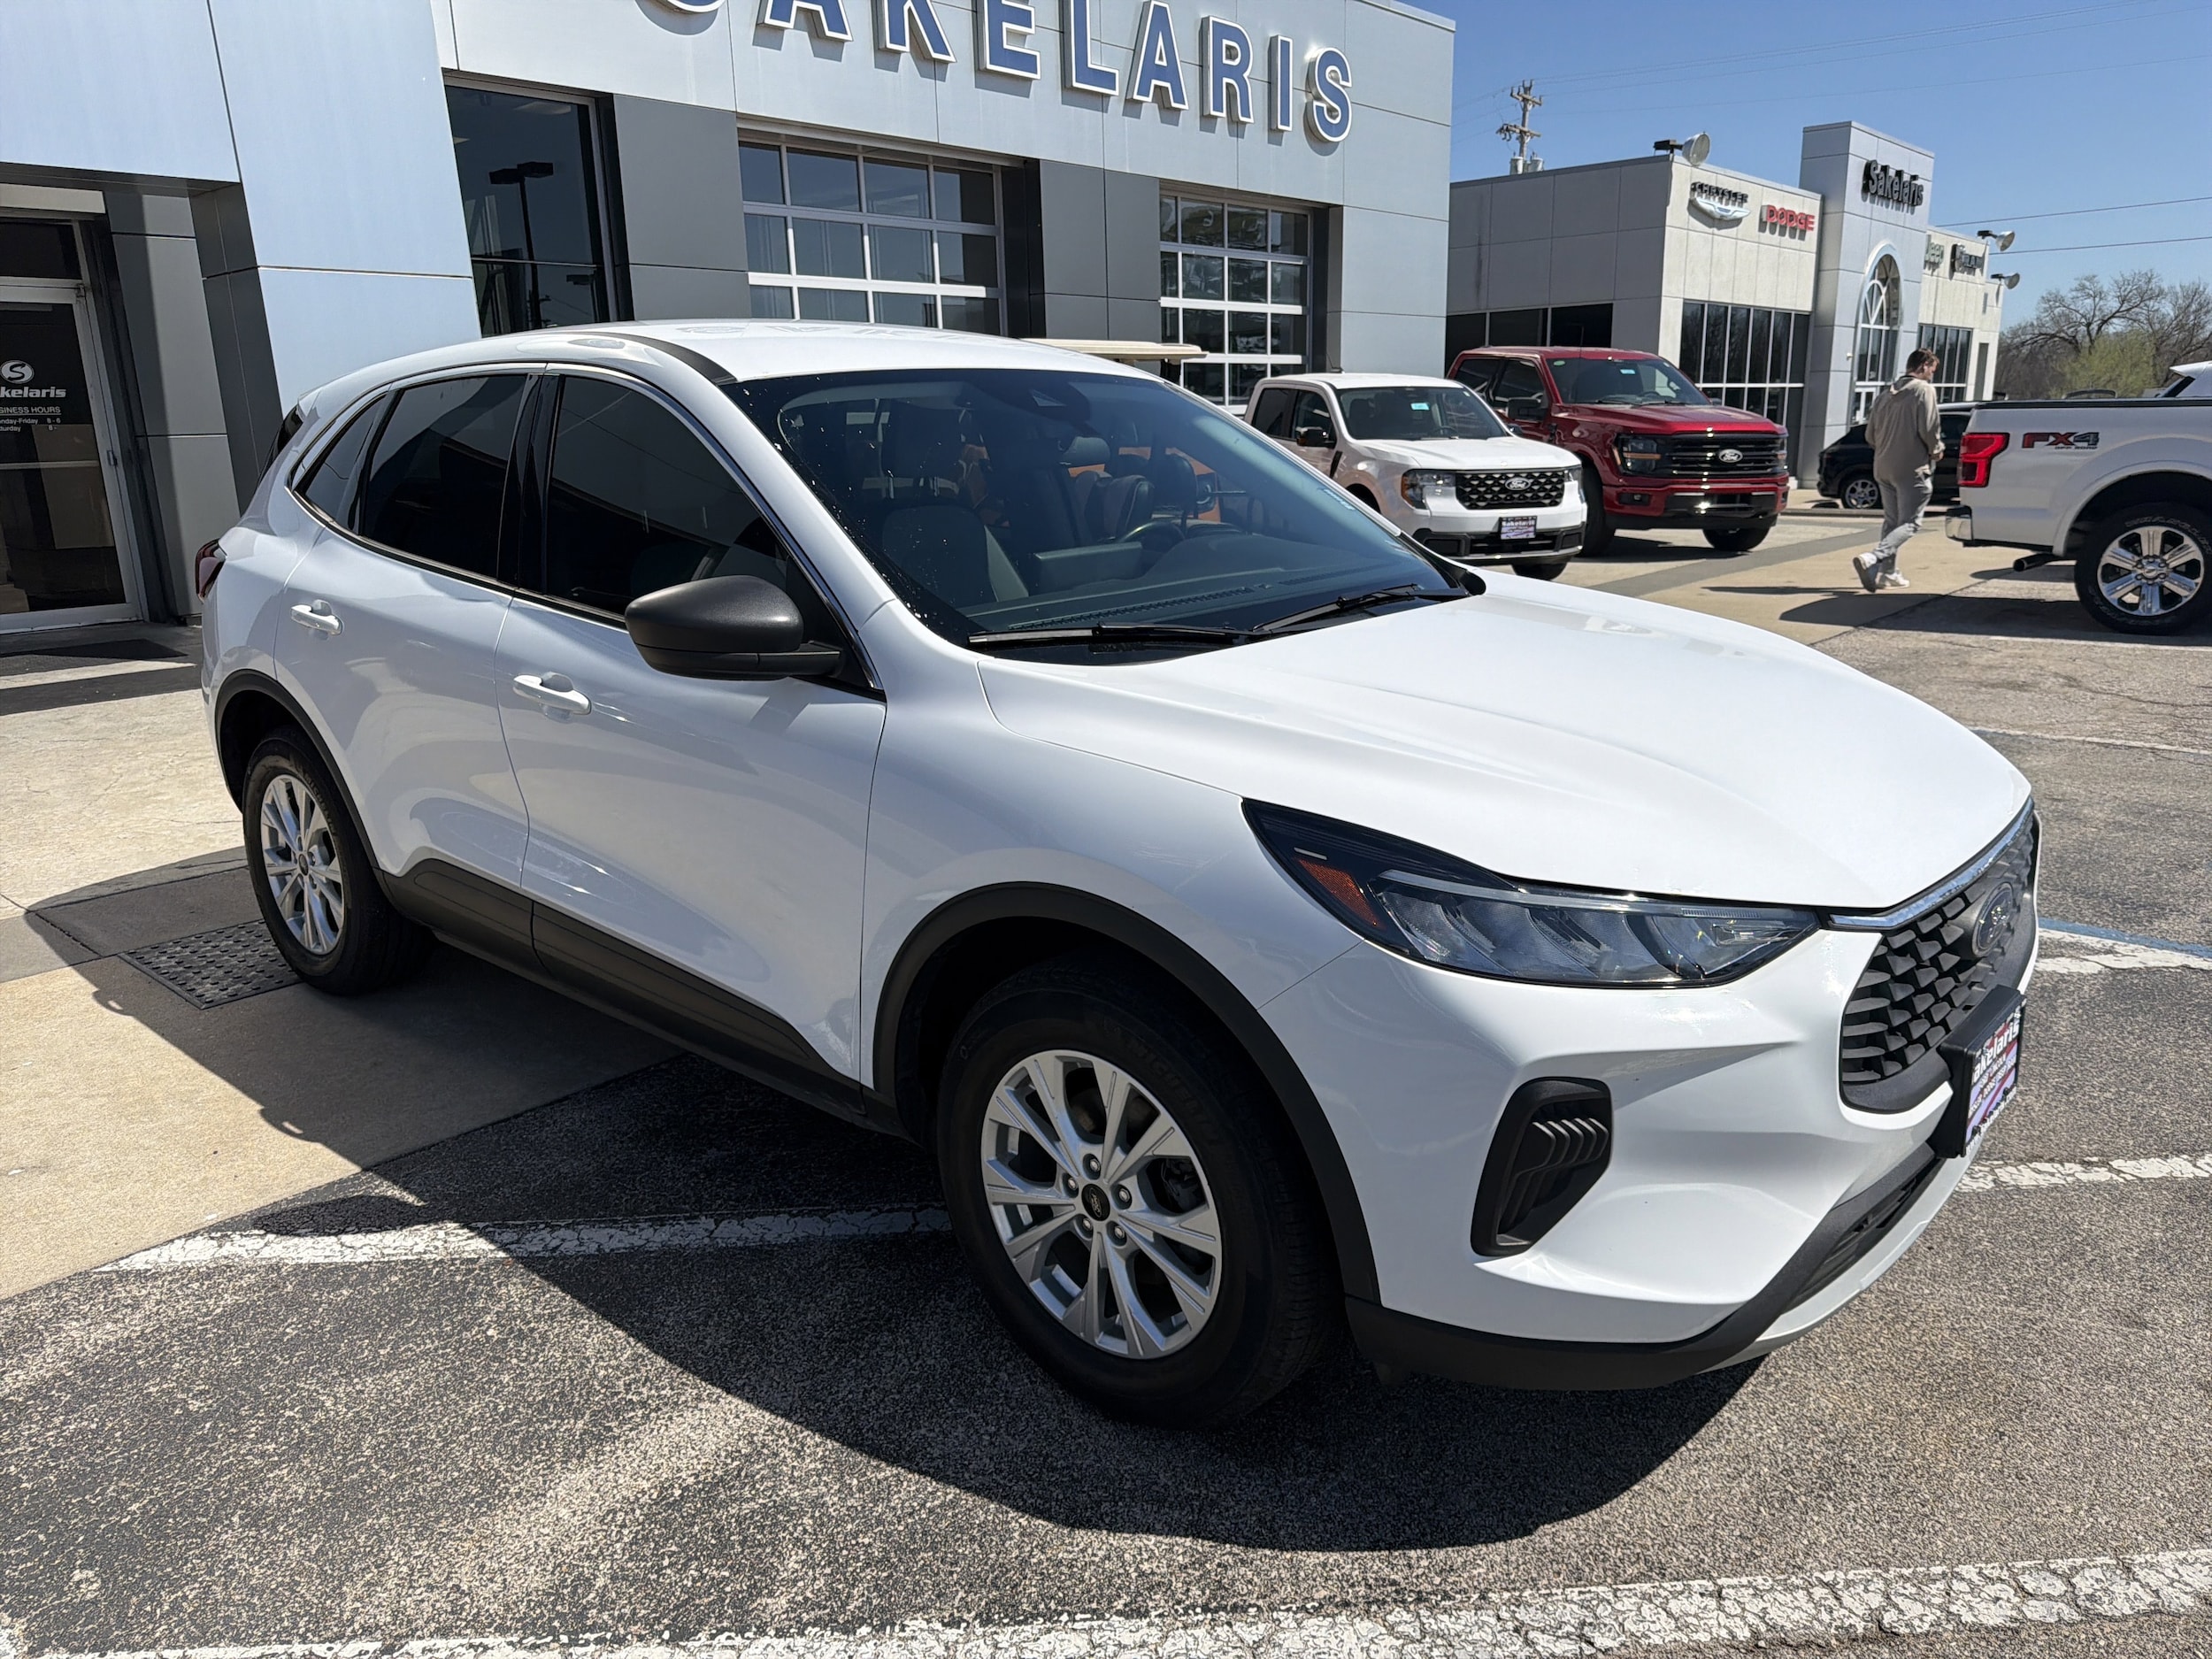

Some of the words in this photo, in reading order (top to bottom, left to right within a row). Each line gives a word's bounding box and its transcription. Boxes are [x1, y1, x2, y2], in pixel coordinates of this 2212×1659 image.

[654, 0, 1352, 142] KELARIS
[1693, 181, 1748, 204] CHRYSLER
[1865, 159, 1924, 206] Sakelaris
[1765, 204, 1816, 232] DODGE
[2022, 432, 2100, 449] FX4
[1972, 1021, 2020, 1085] akelaris
